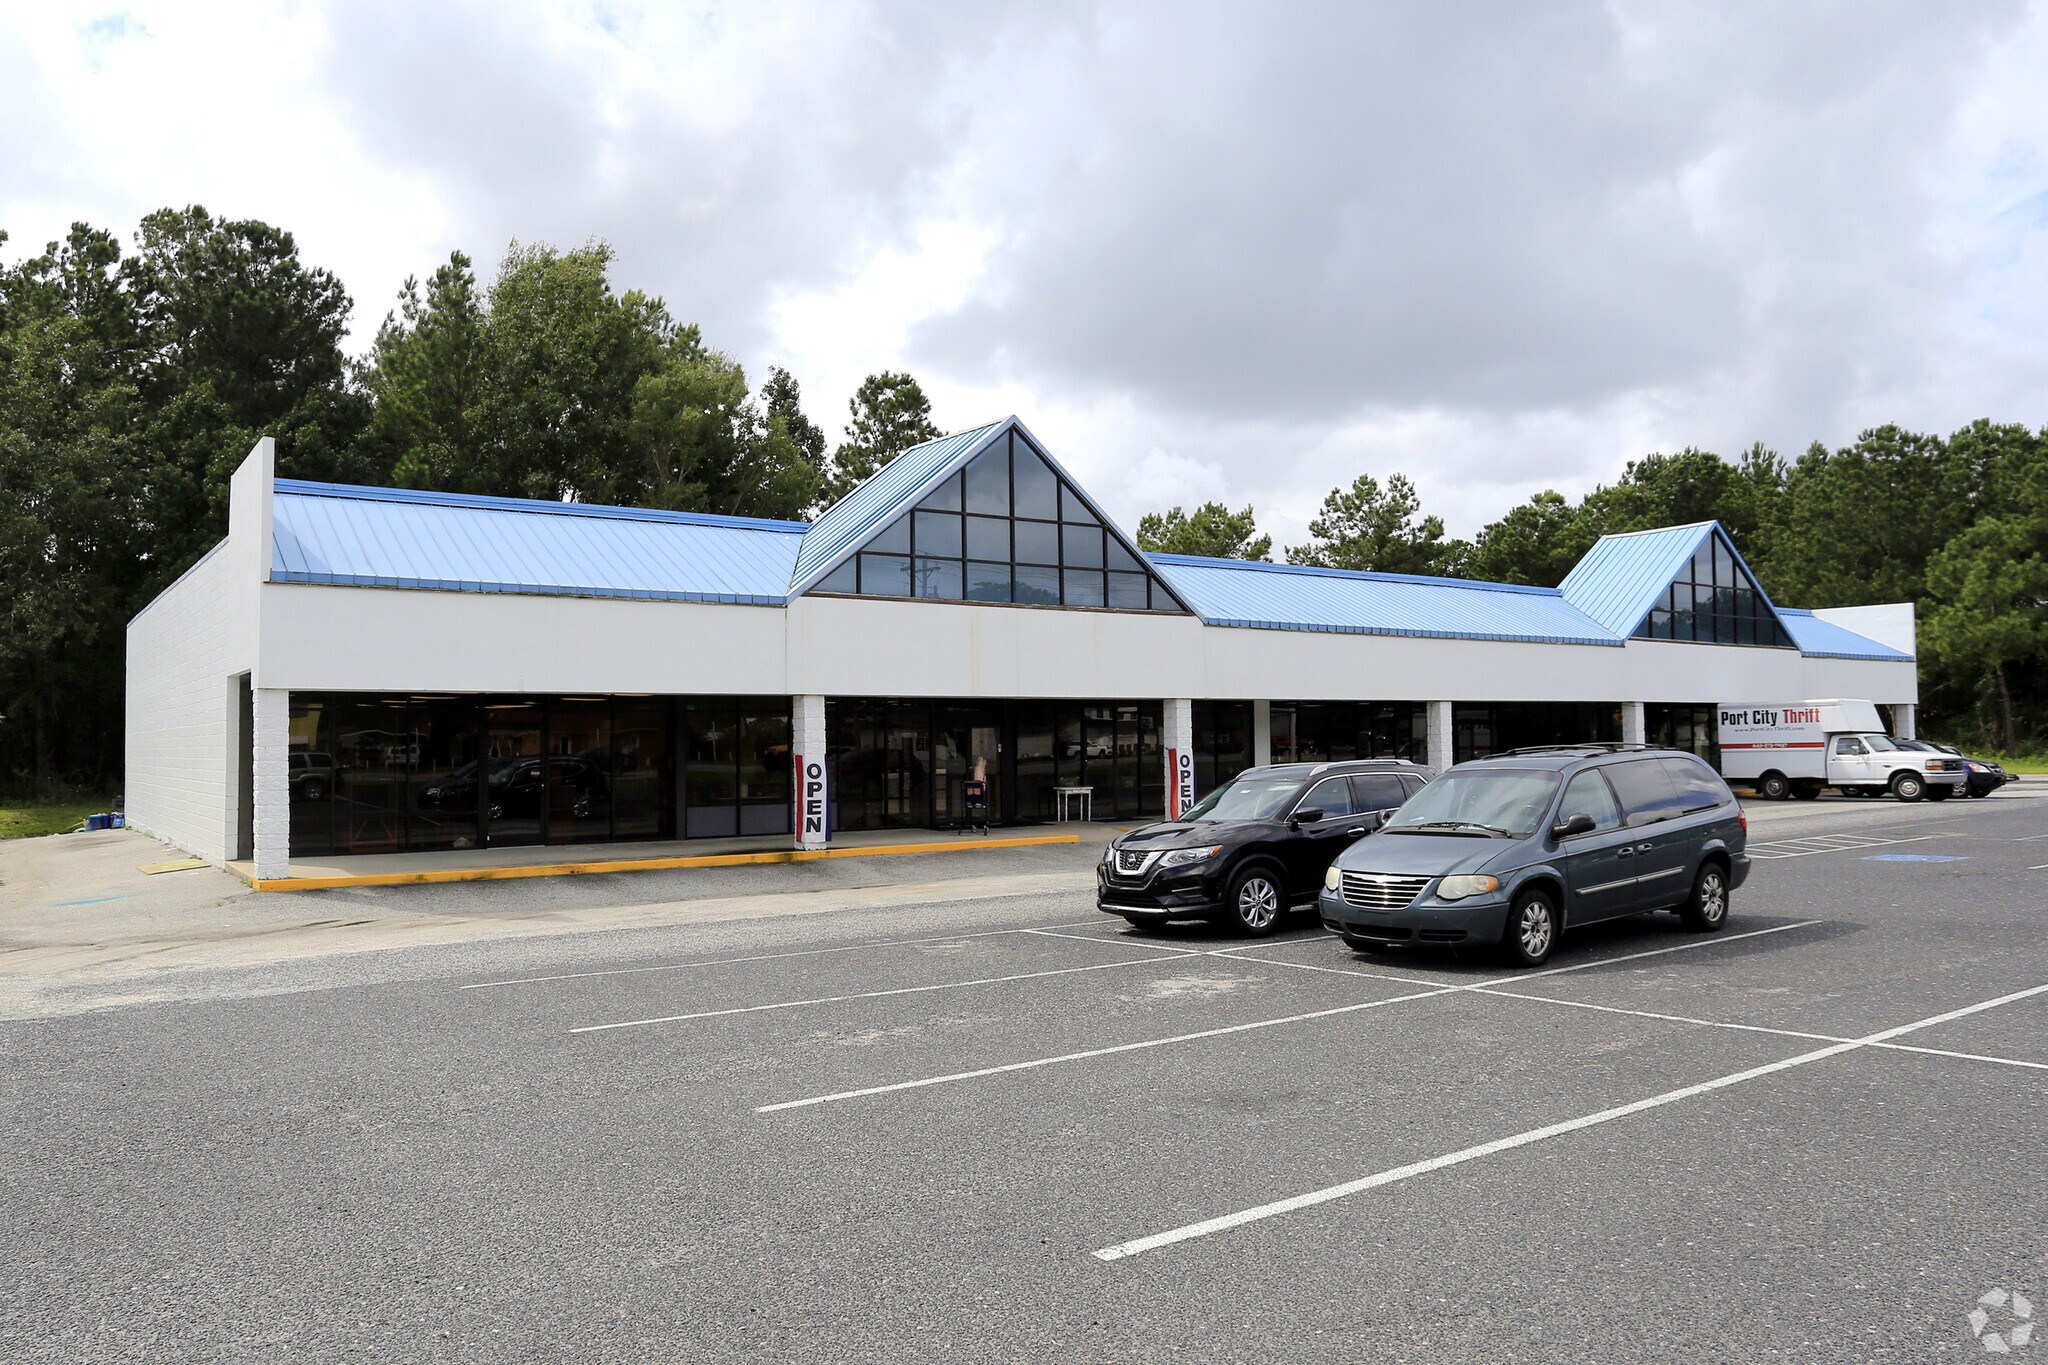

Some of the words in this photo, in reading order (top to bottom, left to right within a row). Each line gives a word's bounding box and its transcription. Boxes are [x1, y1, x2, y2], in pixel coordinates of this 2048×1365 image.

[1721, 711, 1749, 726] Port
[1752, 710, 1778, 727] City
[1782, 708, 1820, 724] Thrift
[806, 763, 823, 833] OPEN
[1180, 755, 1192, 813] OPEN
